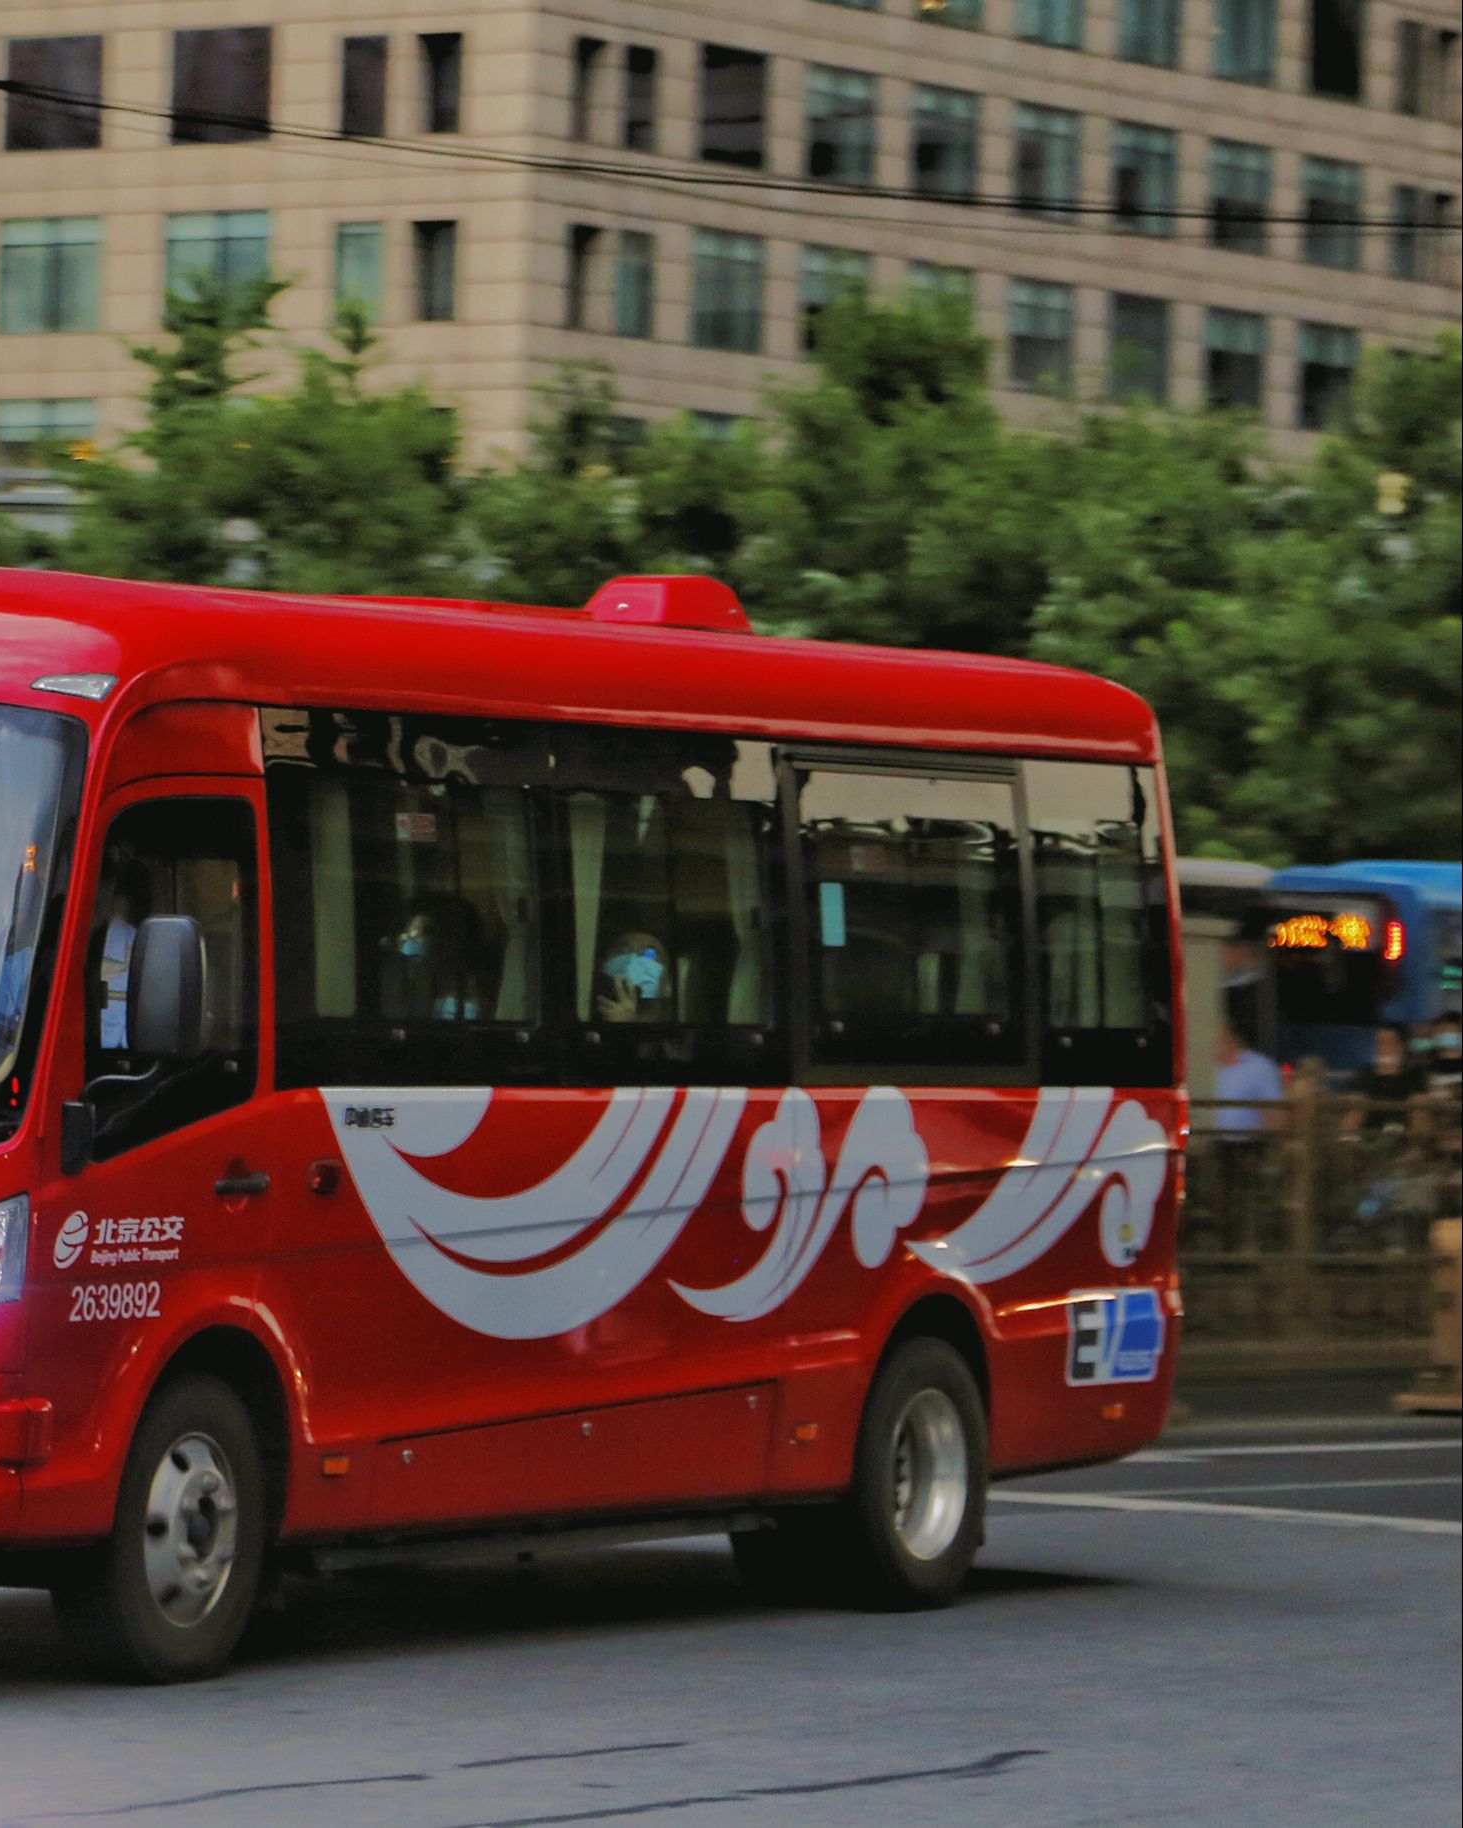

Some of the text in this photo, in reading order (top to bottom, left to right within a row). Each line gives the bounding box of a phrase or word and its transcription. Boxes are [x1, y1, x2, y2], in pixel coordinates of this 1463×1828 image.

[93, 1216, 185, 1244] 北京公交
[69, 1281, 161, 1322] 2639892
